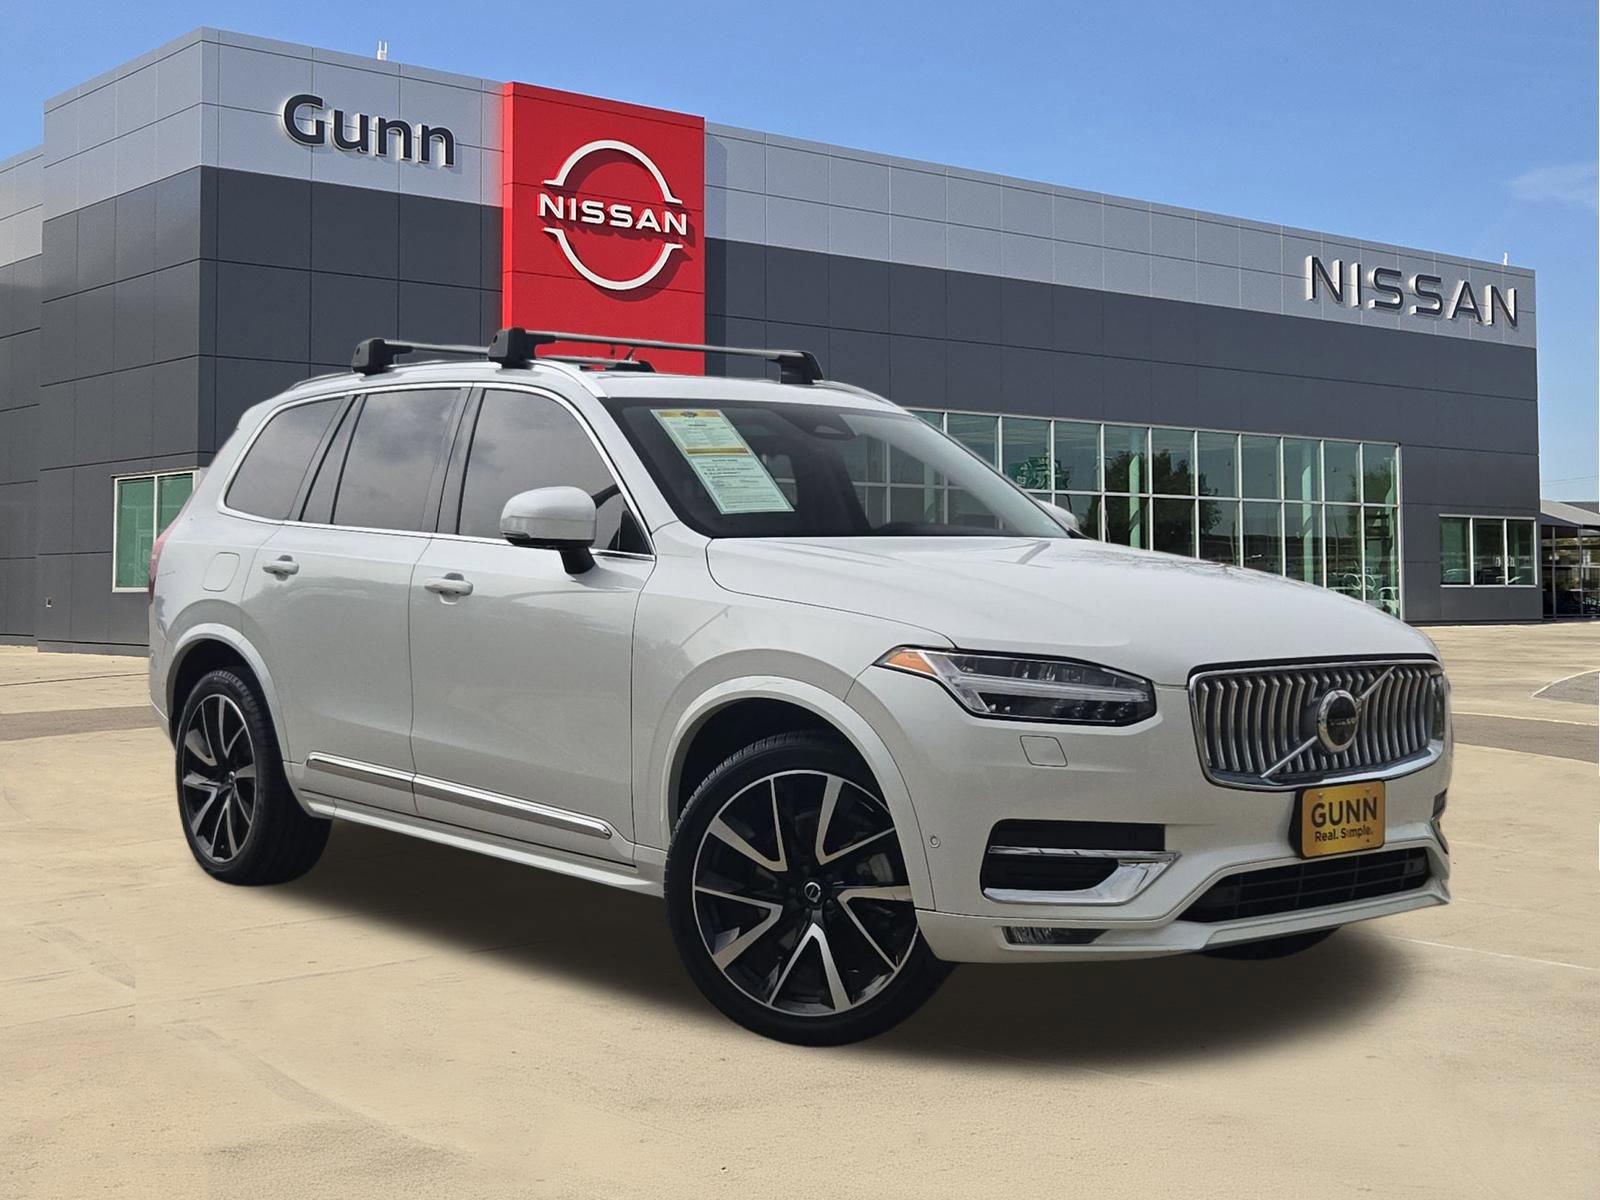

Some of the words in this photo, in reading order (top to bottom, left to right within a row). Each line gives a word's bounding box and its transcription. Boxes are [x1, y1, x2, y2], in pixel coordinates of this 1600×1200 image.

[282, 93, 454, 166] Gunn
[538, 193, 687, 236] NISSAN
[1305, 255, 1518, 328] NISSAN
[1311, 797, 1378, 828] GUNN
[1315, 828, 1339, 842] Real.
